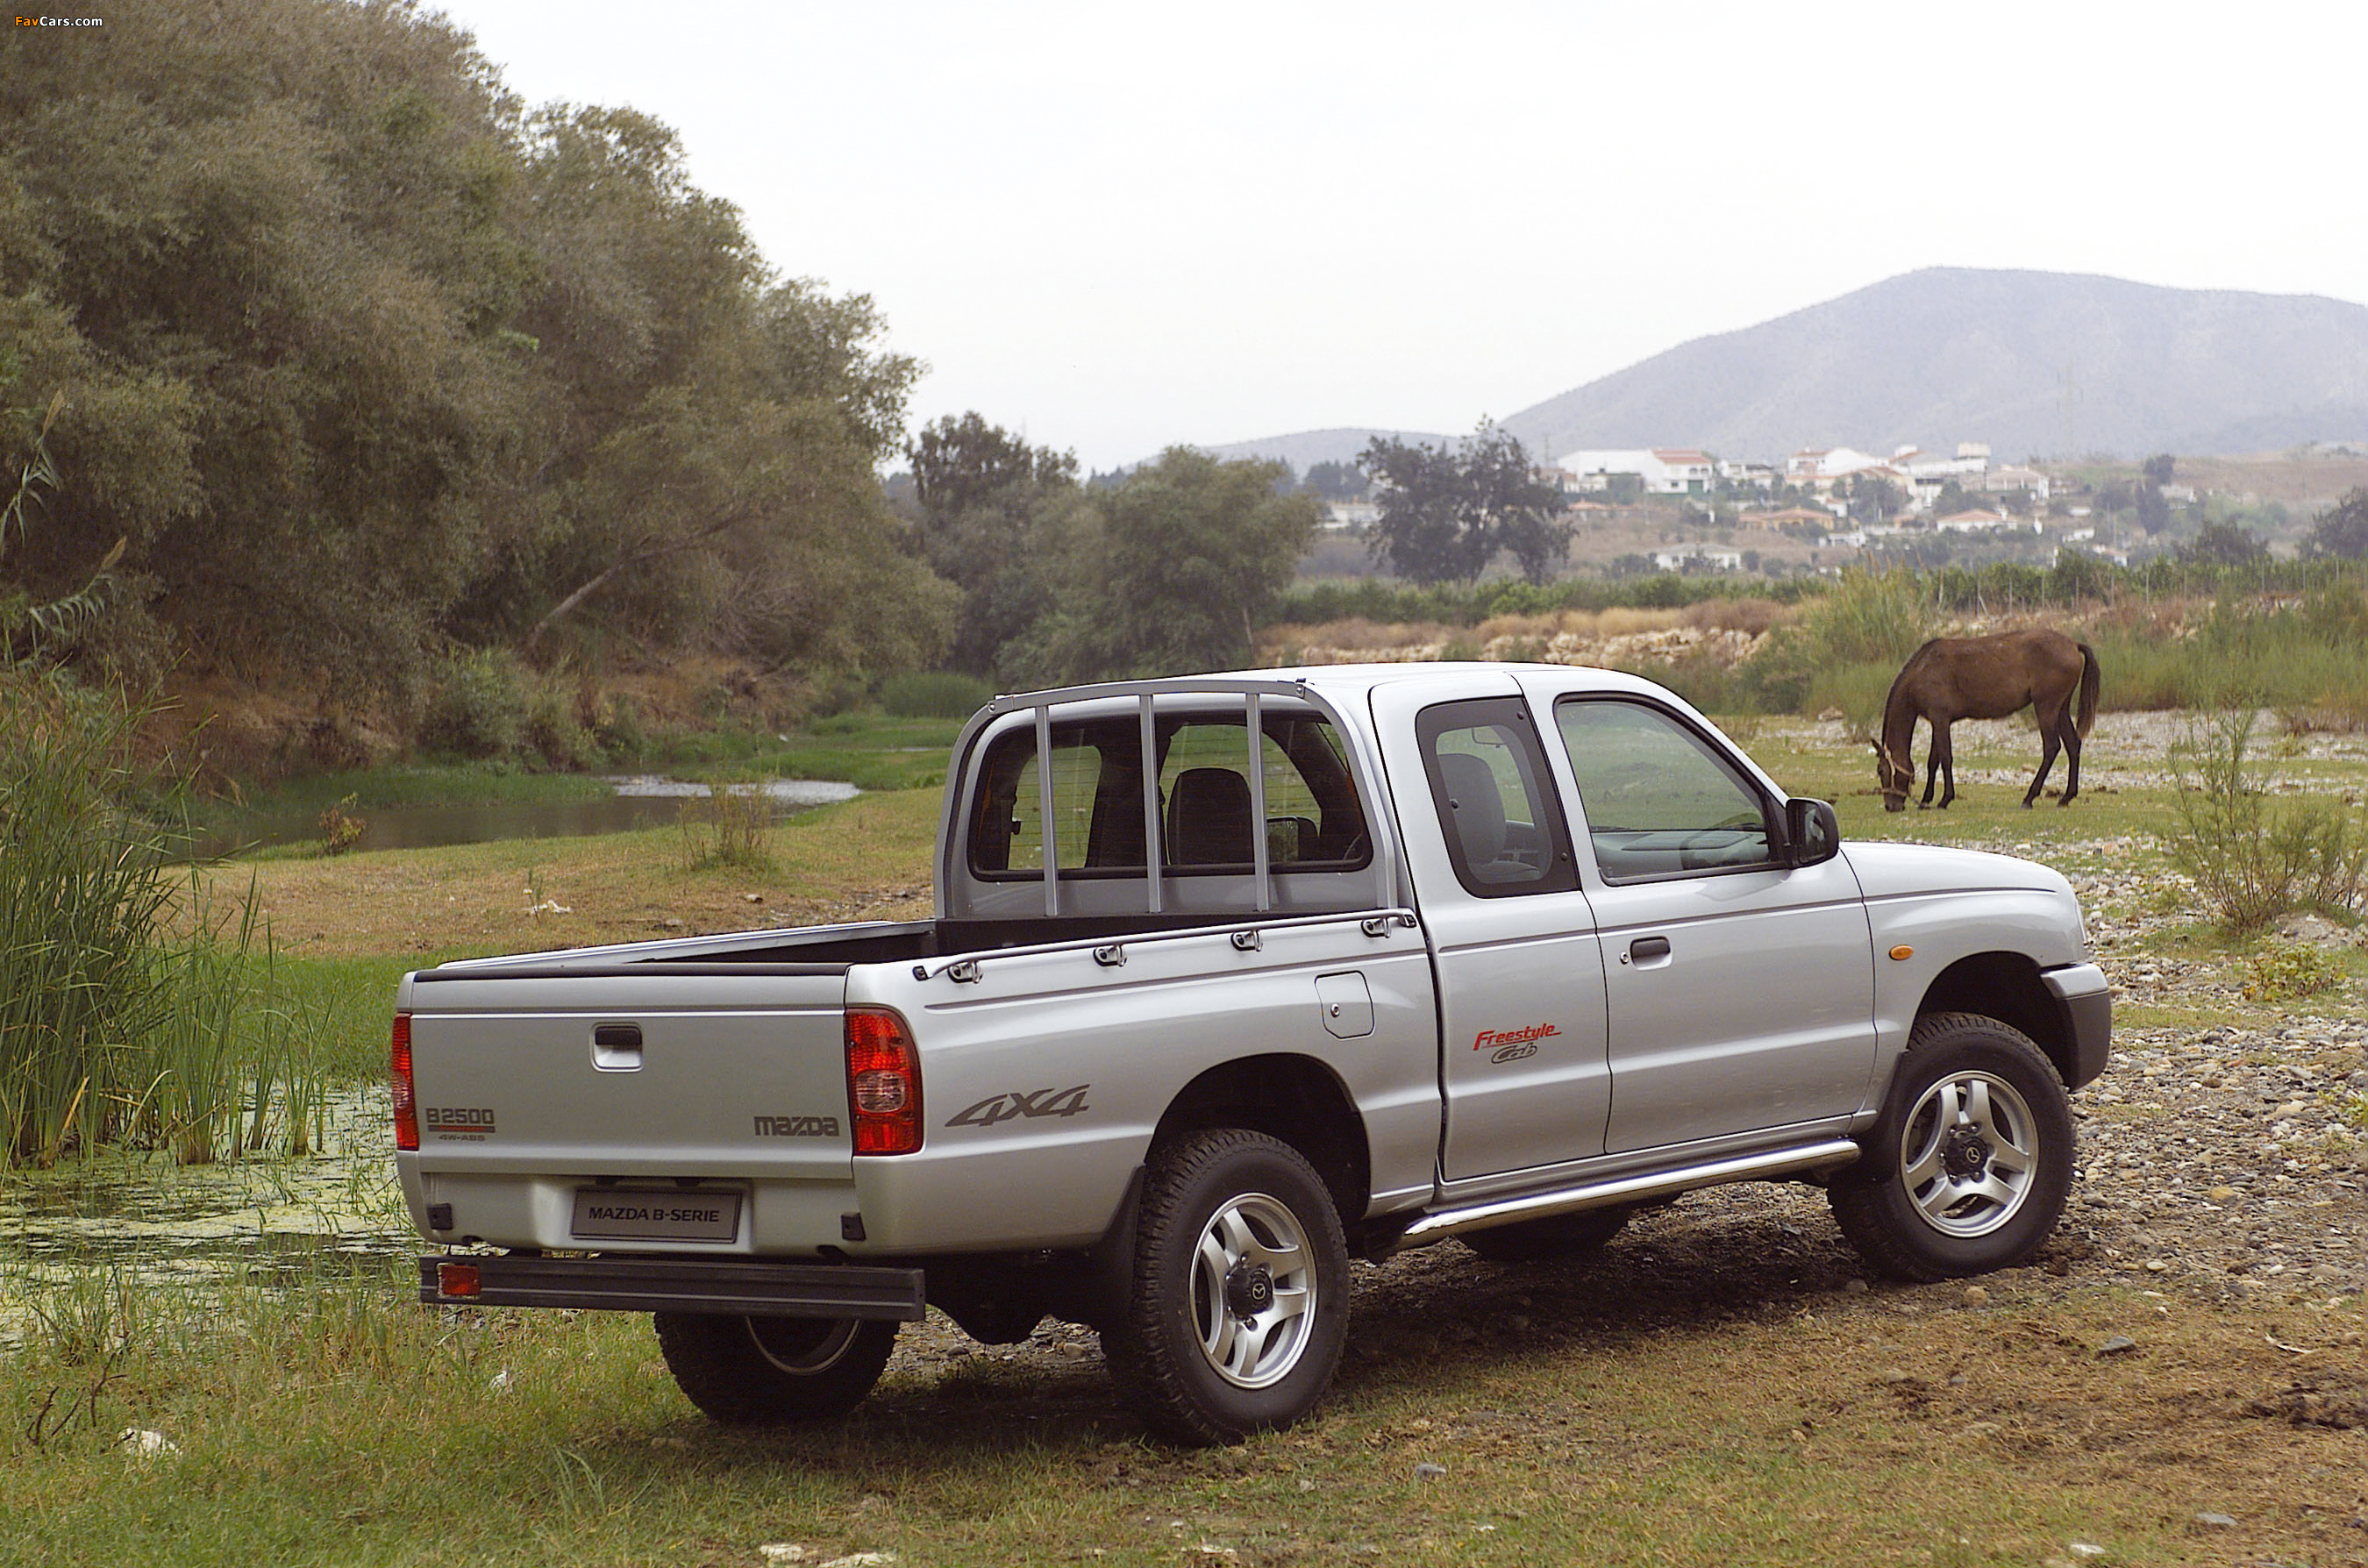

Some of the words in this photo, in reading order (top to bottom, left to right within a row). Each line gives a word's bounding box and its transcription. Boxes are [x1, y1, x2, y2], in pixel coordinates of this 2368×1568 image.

[1473, 1023, 1562, 1051] Freestyle
[1491, 1042, 1537, 1064] Cab
[425, 1108, 495, 1124] B2500
[588, 1207, 649, 1221] MAZDA
[653, 1208, 720, 1222] B-SERIE
